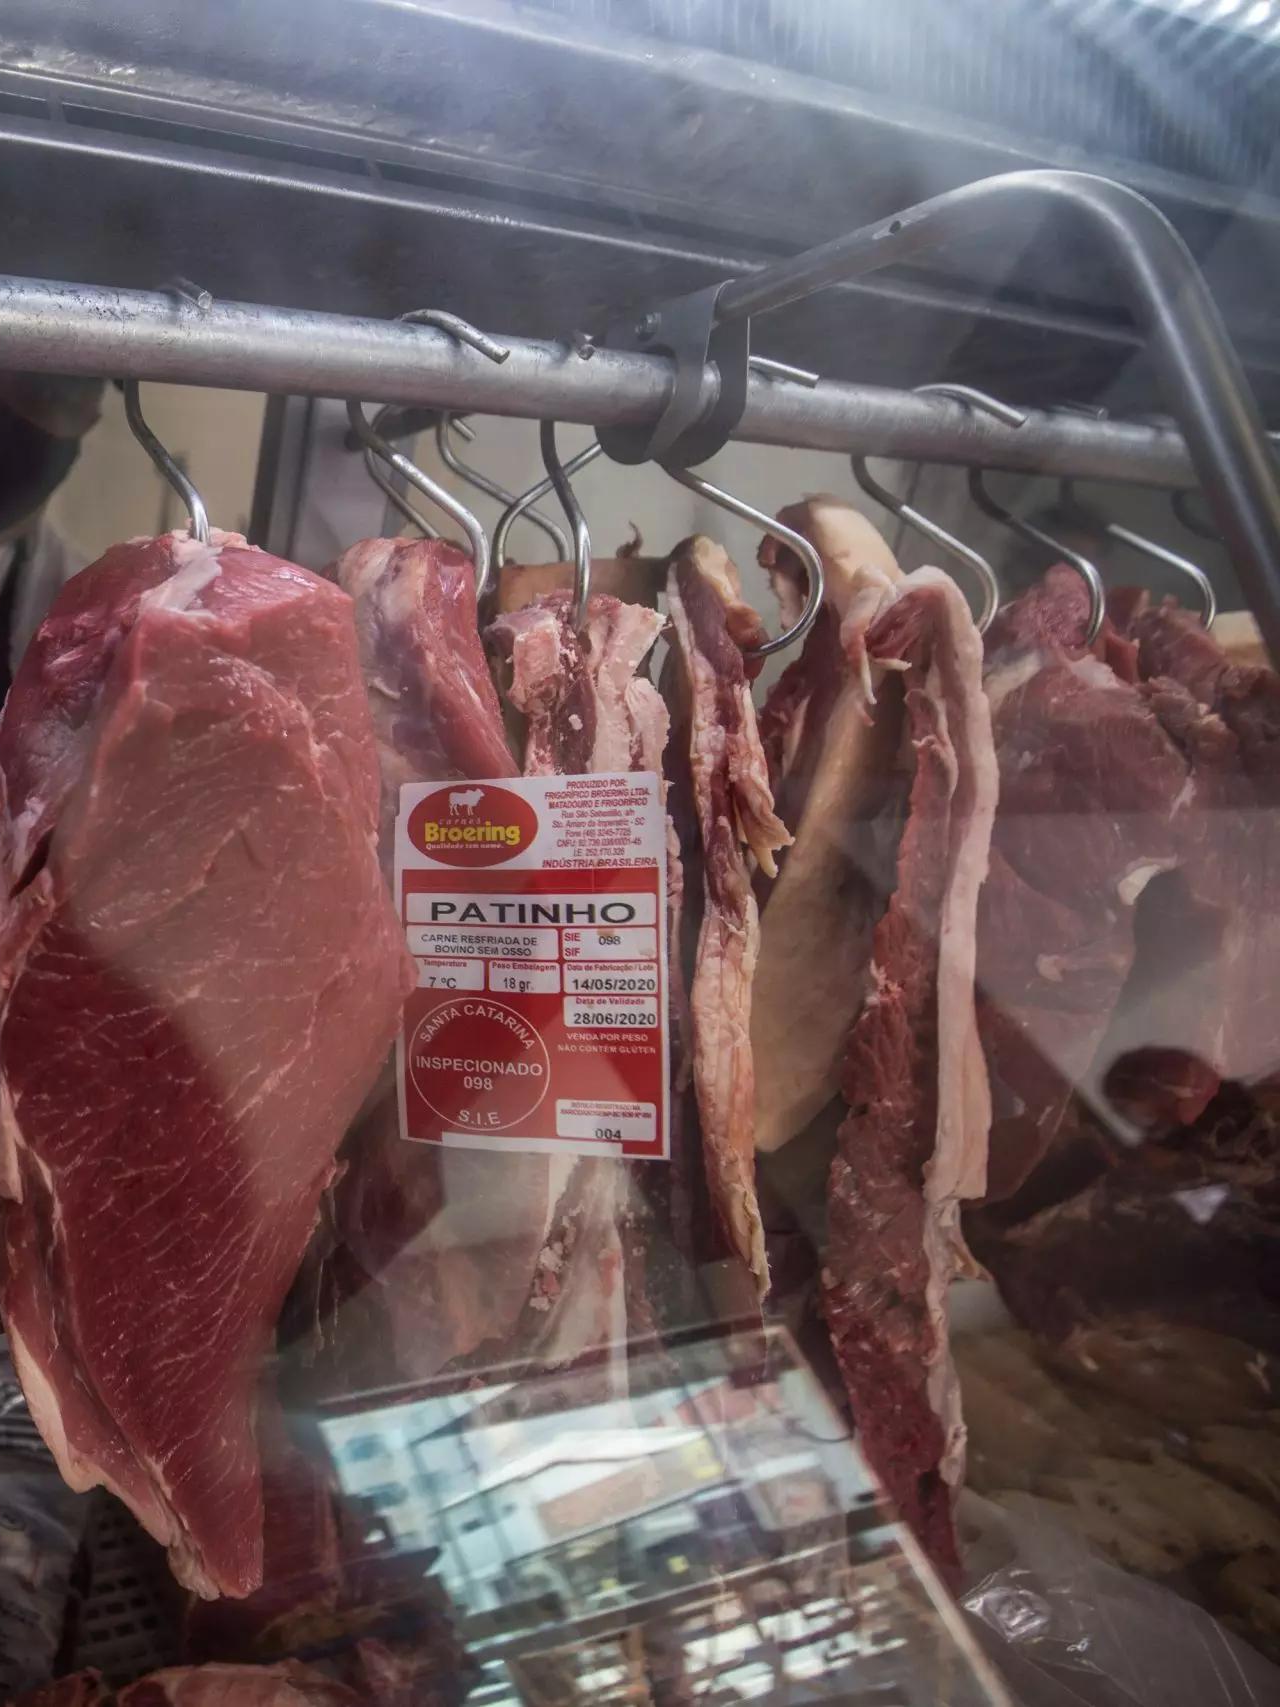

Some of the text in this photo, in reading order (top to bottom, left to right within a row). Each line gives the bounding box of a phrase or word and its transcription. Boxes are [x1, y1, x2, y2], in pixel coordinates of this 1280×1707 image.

[566, 780, 608, 789] PRODUZIDO
[591, 789, 629, 798] BROERING
[548, 800, 593, 809] MATADOURO
[425, 821, 520, 845] Broering
[542, 857, 657, 868] INDÚSTRIA BRASILEIRA
[431, 902, 635, 923] PATINHO
[421, 934, 537, 945] CARNE RESFRIADA DE
[564, 933, 581, 942] SIE
[599, 936, 621, 945] 098
[434, 945, 532, 956] BOVINO SEM OSSO
[564, 948, 581, 956] SIF
[423, 959, 467, 967] Temperatura
[512, 962, 557, 971] Embalagem
[429, 976, 436, 987] 7
[503, 978, 515, 988] 18
[572, 978, 655, 990] 14/05/2020
[573, 1013, 656, 1025] 28/06/2020
[420, 1004, 535, 1050] SANTA CATARINA
[600, 1033, 620, 1041] POR
[557, 1044, 577, 1052] NÃO
[416, 1055, 543, 1076] INSPECIONADO
[463, 1075, 493, 1090] 098
[458, 1108, 501, 1125] S.I.E
[595, 1128, 622, 1139] 004
